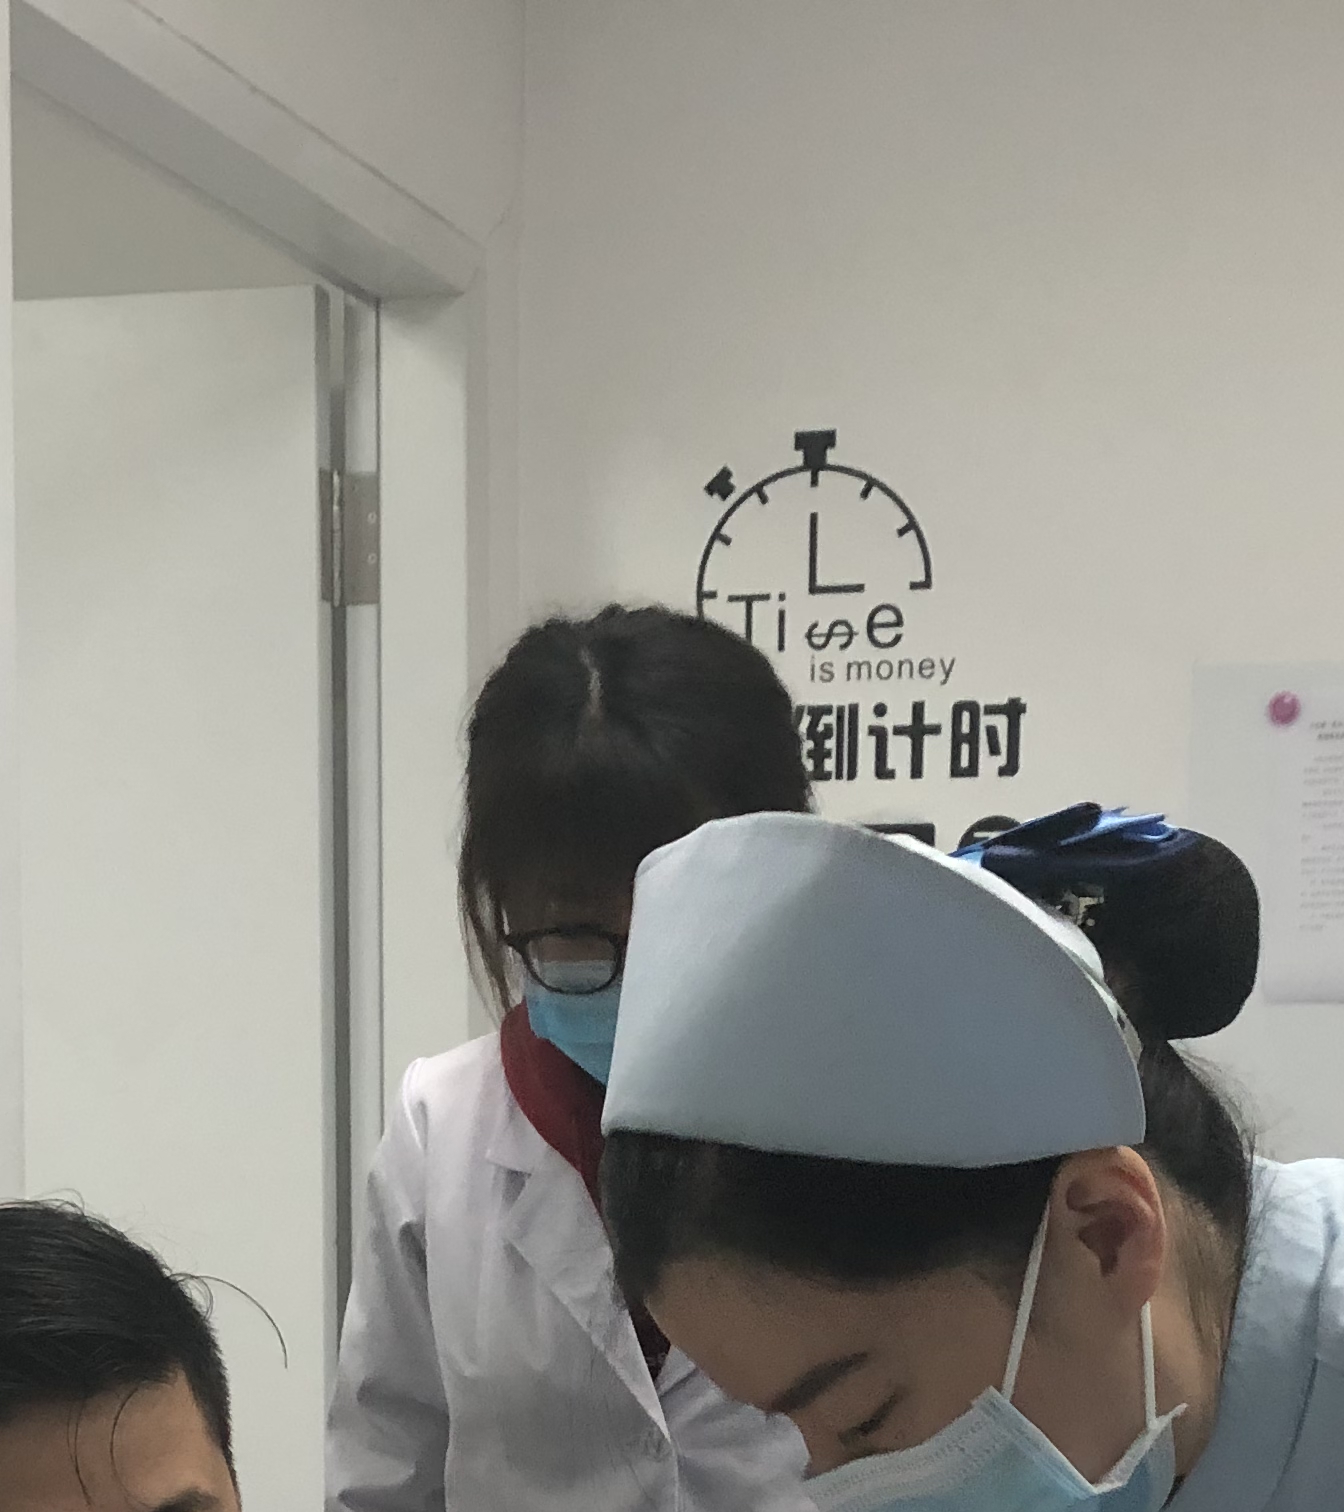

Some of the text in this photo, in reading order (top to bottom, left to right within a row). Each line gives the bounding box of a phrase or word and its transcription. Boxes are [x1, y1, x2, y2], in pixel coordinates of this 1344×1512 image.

[809, 655, 956, 686] is money
[792, 697, 1027, 781] 倒计时
